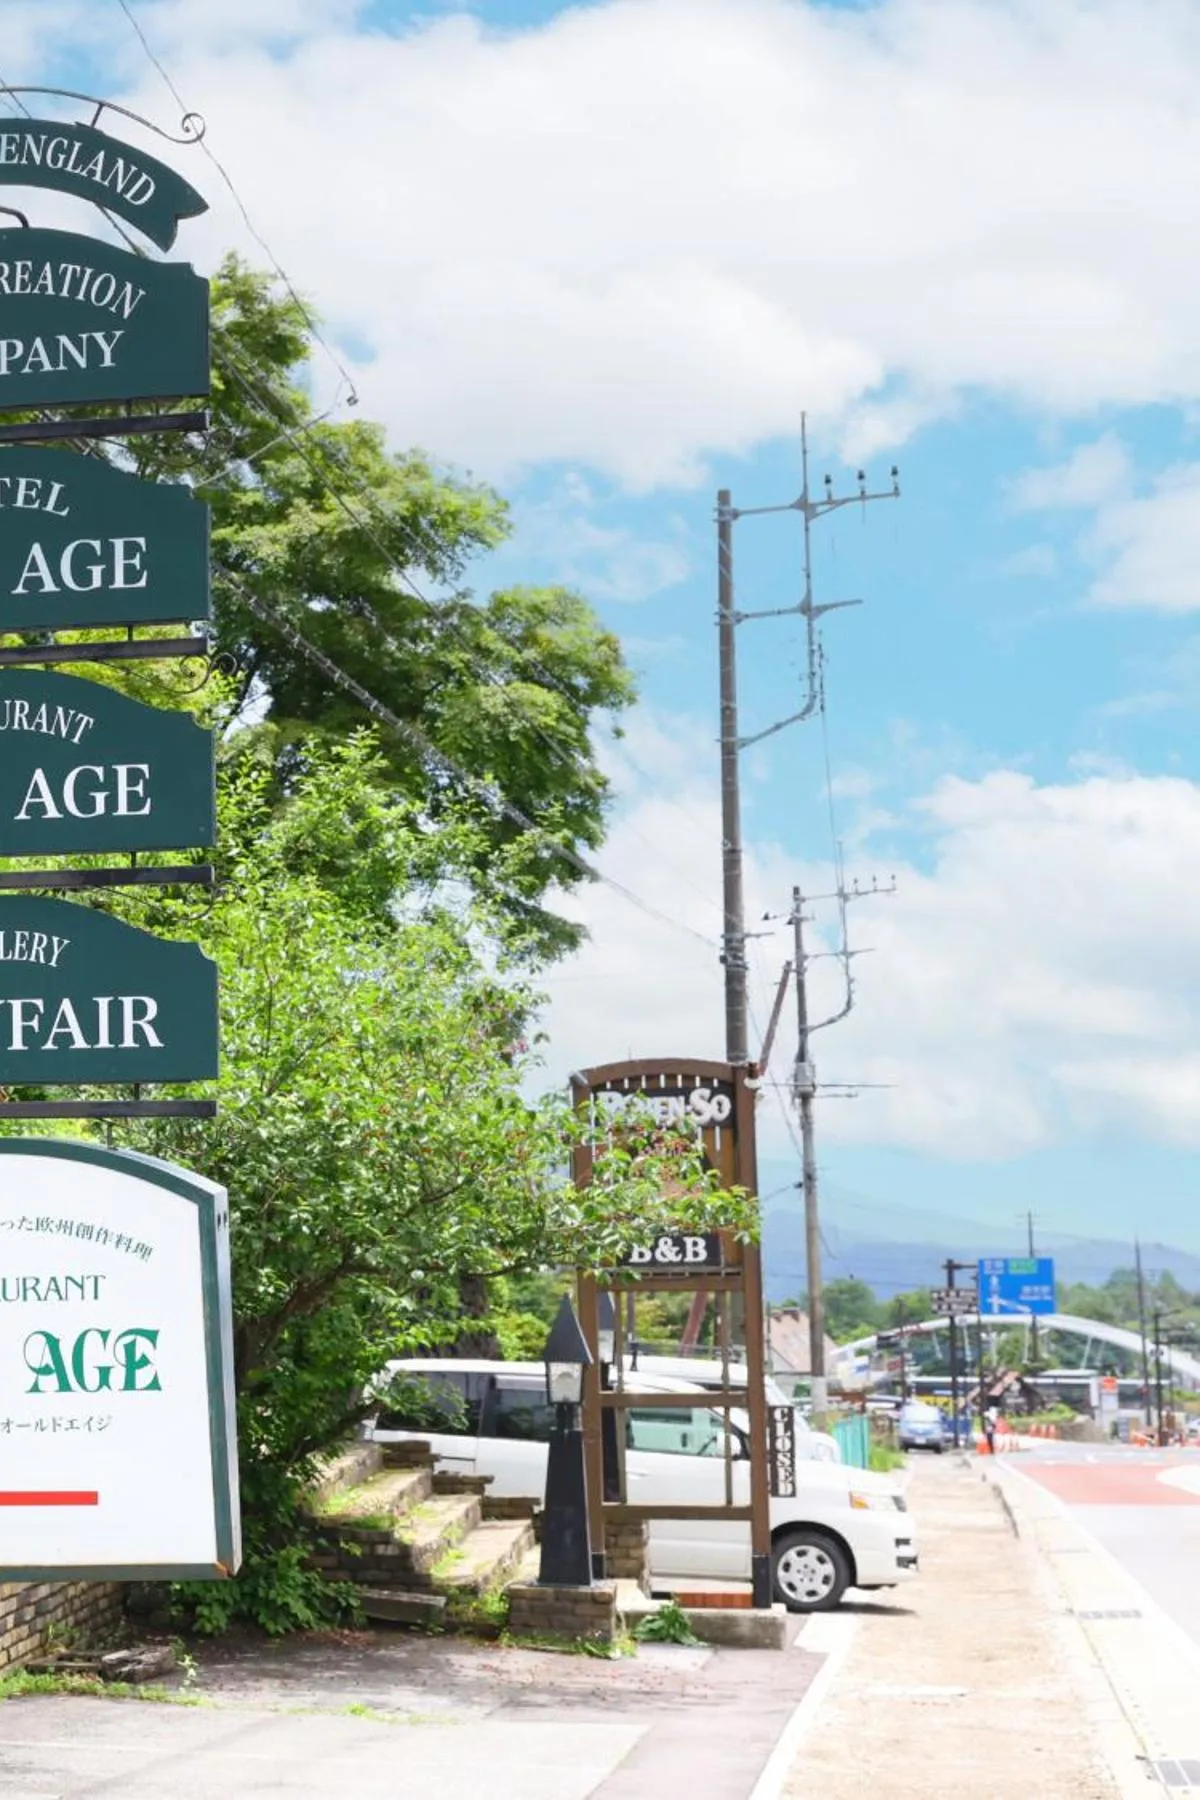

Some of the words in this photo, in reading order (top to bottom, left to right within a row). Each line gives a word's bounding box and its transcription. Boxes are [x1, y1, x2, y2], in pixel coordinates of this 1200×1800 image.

[11, 537, 148, 594] AGE
[14, 763, 151, 820] AGE
[629, 1236, 708, 1263] B&B
[23, 1327, 163, 1394] AGE
[0, 1414, 112, 1435] オールドエイジ
